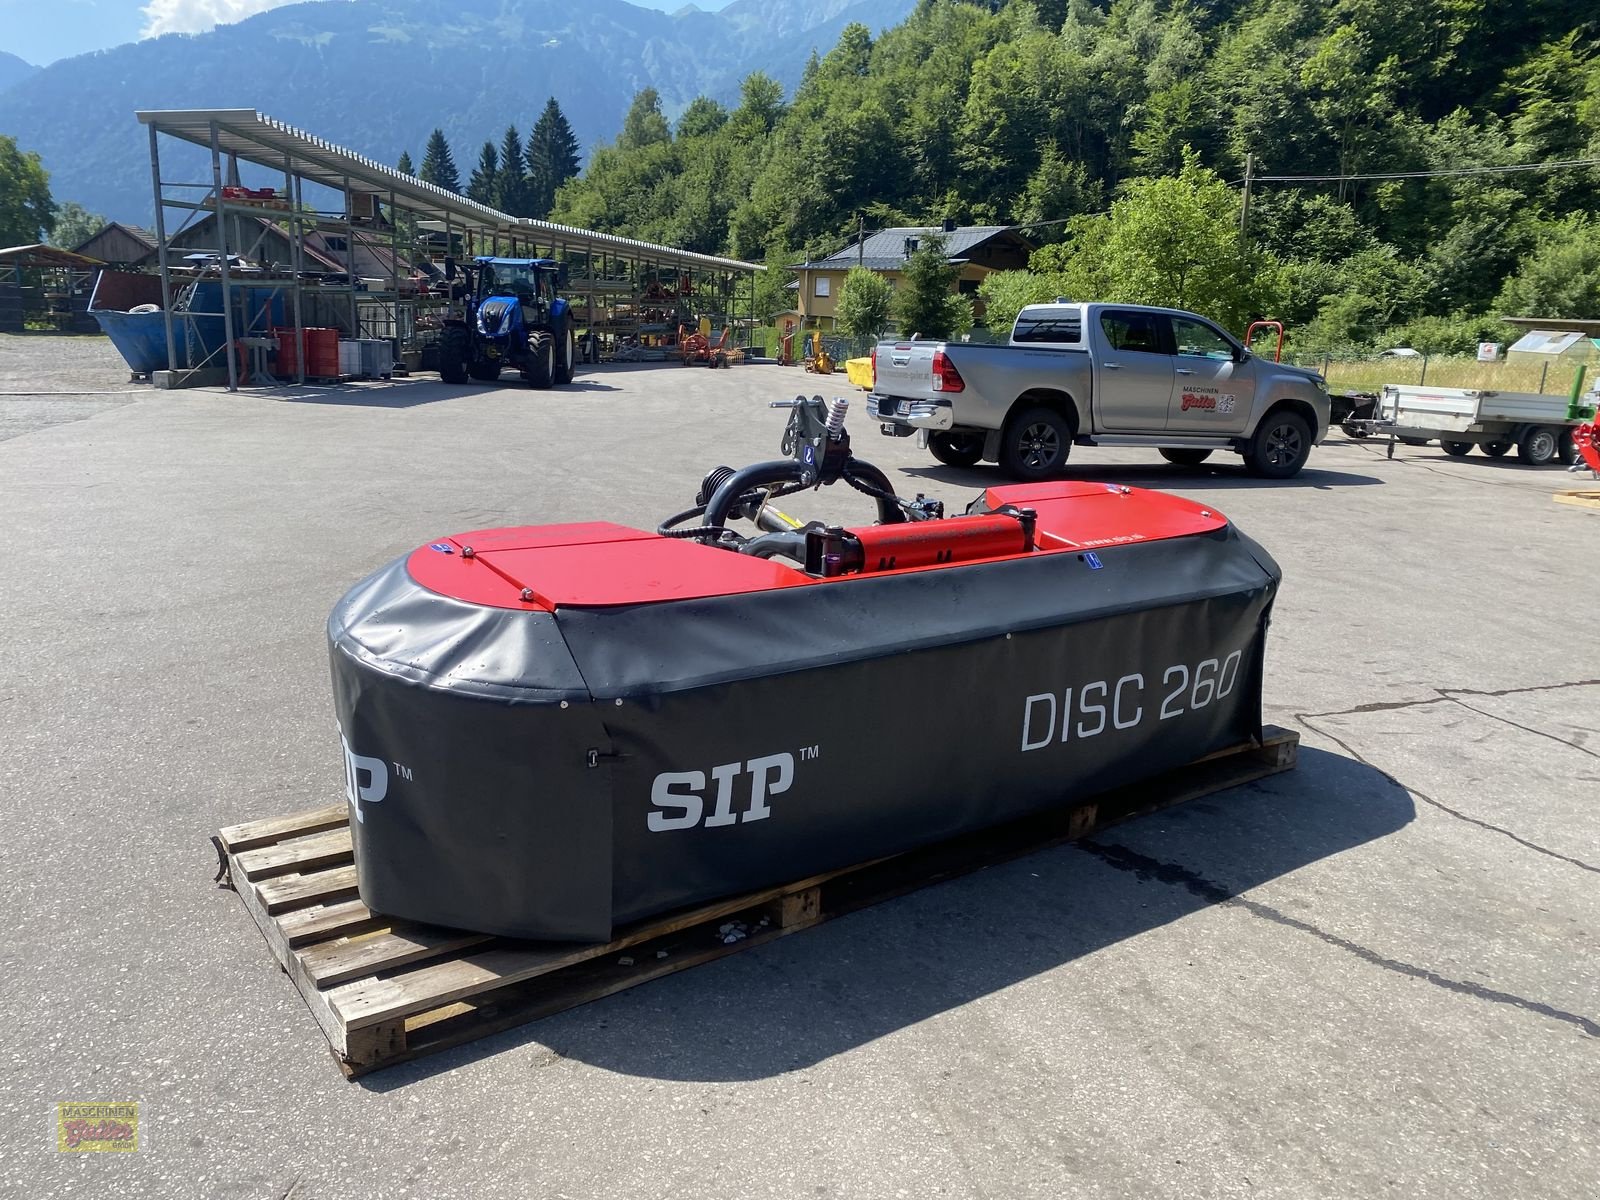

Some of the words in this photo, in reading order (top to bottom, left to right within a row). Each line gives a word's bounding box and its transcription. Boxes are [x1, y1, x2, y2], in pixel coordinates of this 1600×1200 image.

[1183, 386, 1219, 394] MASCHINEN
[1021, 673, 1144, 752] DISC
[1159, 649, 1242, 720] 260
[647, 752, 795, 832] SIP
